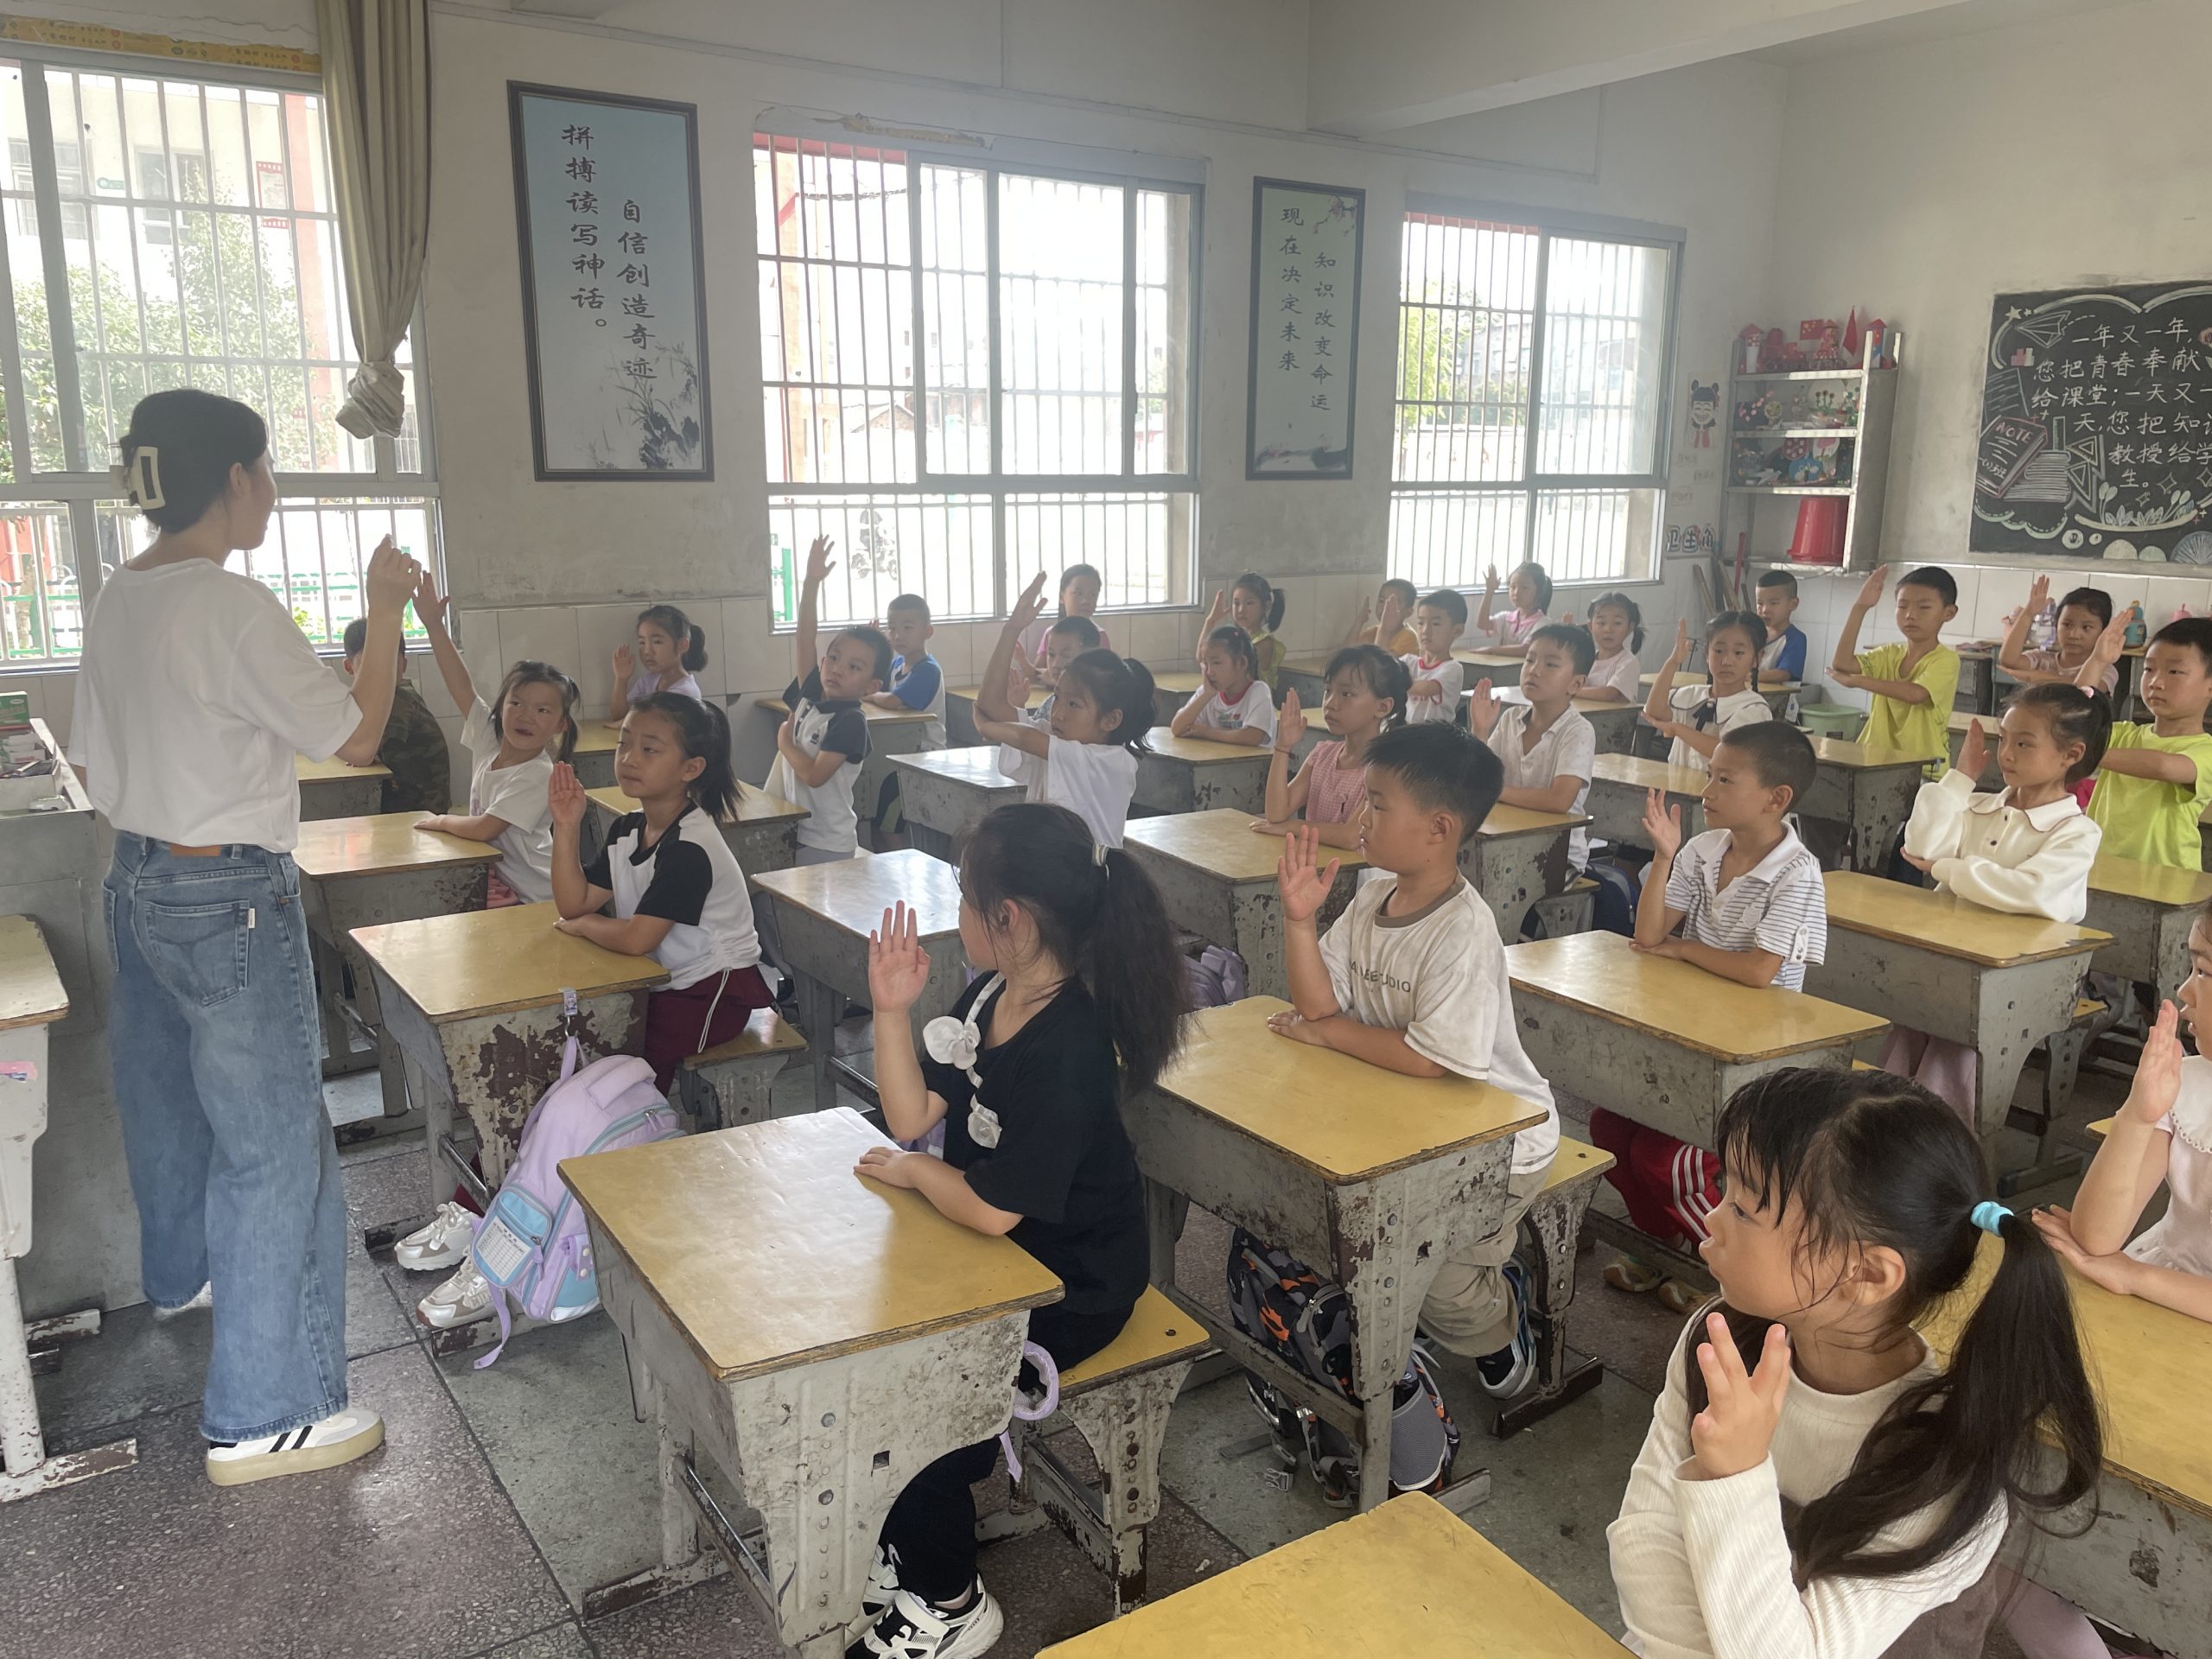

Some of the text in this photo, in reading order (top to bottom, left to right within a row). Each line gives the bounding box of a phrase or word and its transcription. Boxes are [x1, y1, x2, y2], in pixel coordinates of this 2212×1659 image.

[616, 199, 657, 380] 自信创造奇迹
[1278, 207, 1305, 372] 现在决定未来
[1309, 251, 1337, 411] 知识改变命运
[2033, 346, 2202, 382] 您把青春奉献
[1995, 421, 2034, 444] NOTE
[2120, 468, 2149, 488] 生。
